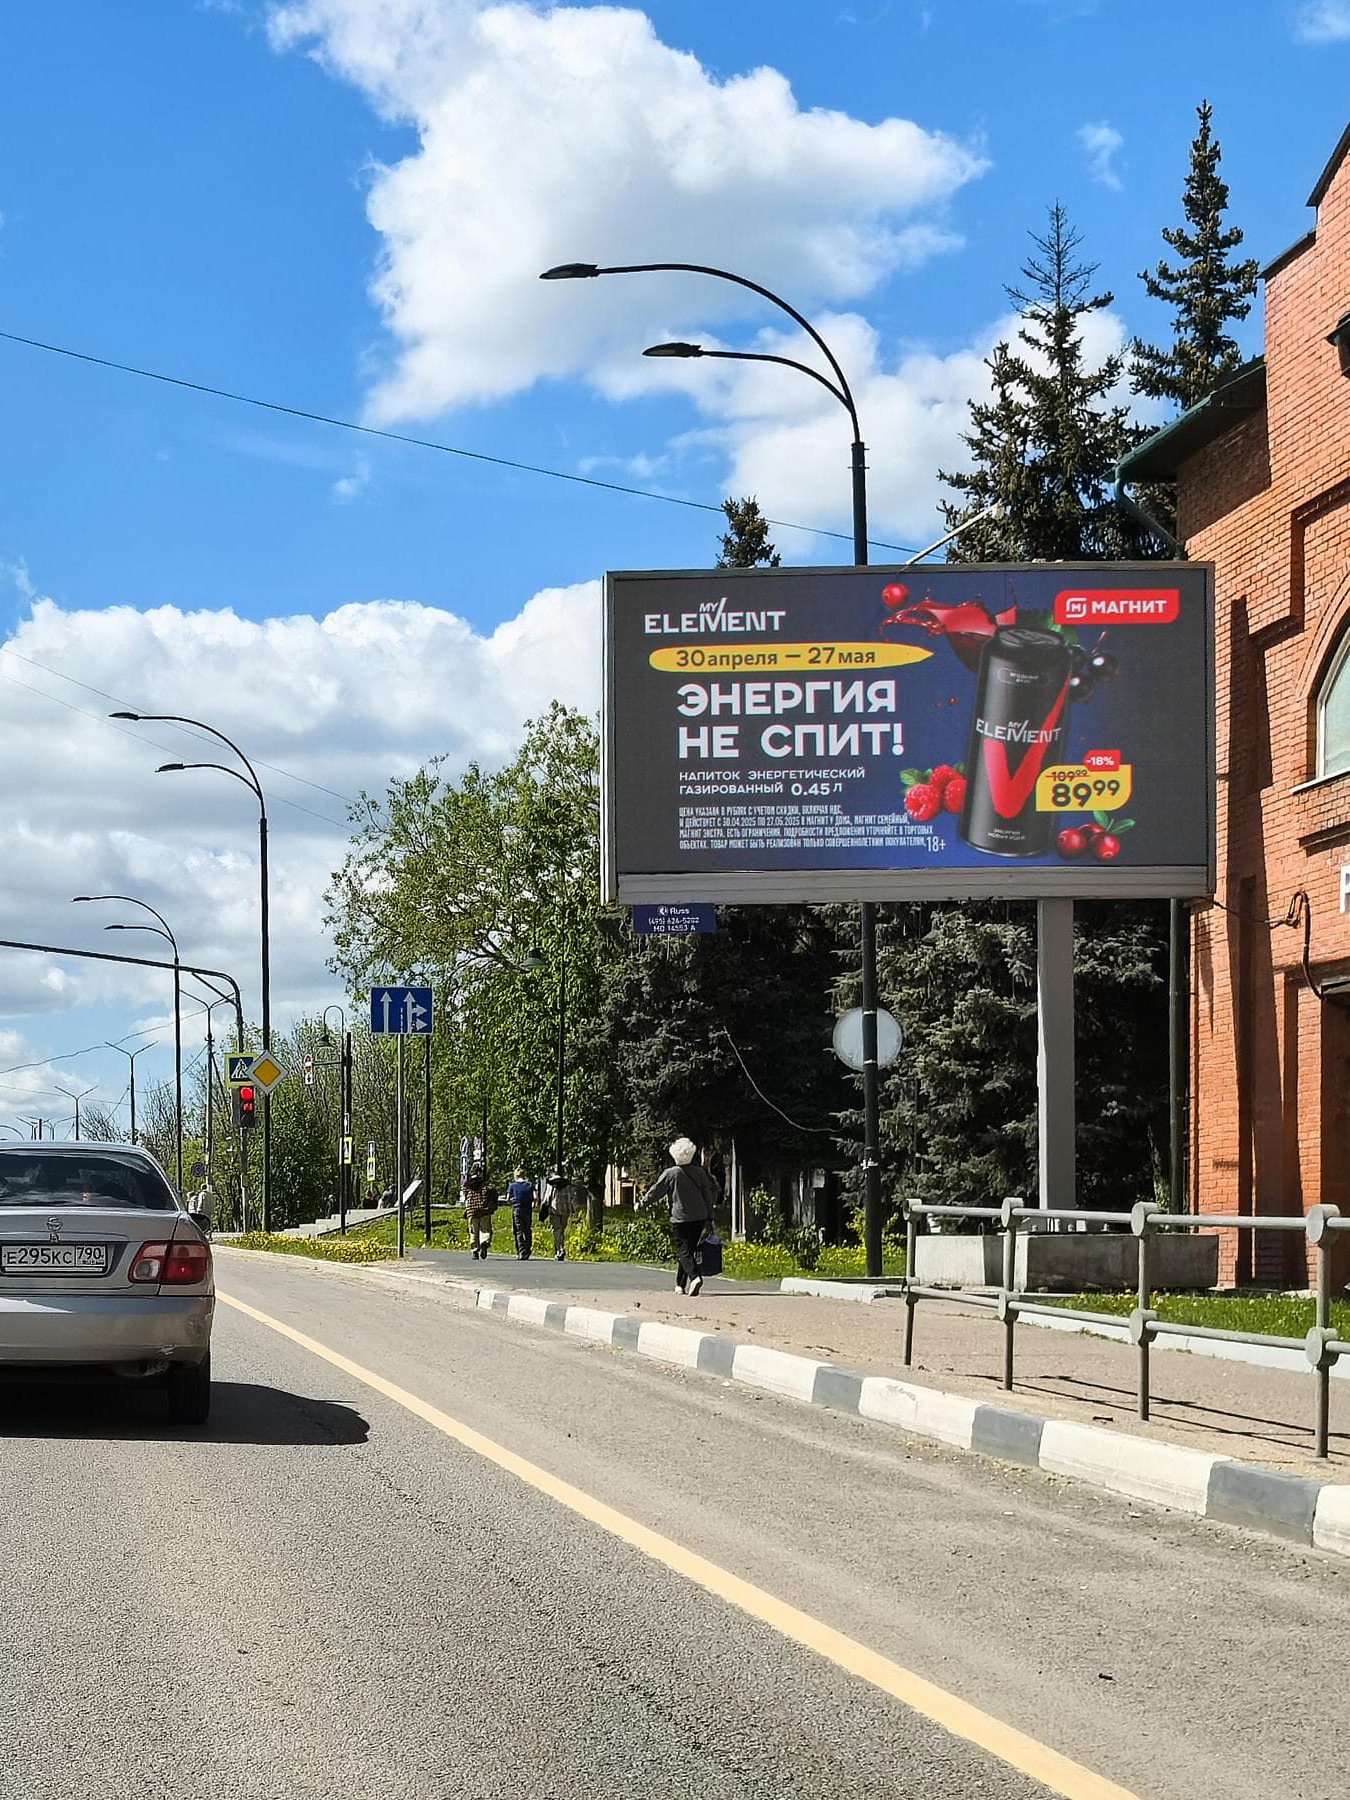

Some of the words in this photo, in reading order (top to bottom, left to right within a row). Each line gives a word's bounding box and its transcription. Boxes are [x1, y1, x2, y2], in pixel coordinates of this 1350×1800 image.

[699, 602, 719, 613] MY
[1091, 600, 1167, 614] МАГНИТ
[645, 597, 786, 634] ELEMENT
[676, 650, 705, 667] 30
[708, 651, 778, 670] апреля
[808, 647, 836, 664] 27
[838, 651, 875, 664] мая
[676, 680, 896, 717] ЭНЕРГИЯ
[678, 725, 739, 759] НЕ
[760, 723, 904, 758] СПИТ!
[1086, 756, 1115, 766] -18%
[678, 771, 740, 781] НАПИТОК
[747, 767, 865, 780] ЭНЕРГЕТИЧЕСКИЙ
[678, 782, 784, 795] ГАЗИРОВАННЫЙ
[790, 783, 830, 796] 0.45
[926, 836, 946, 852] 18+
